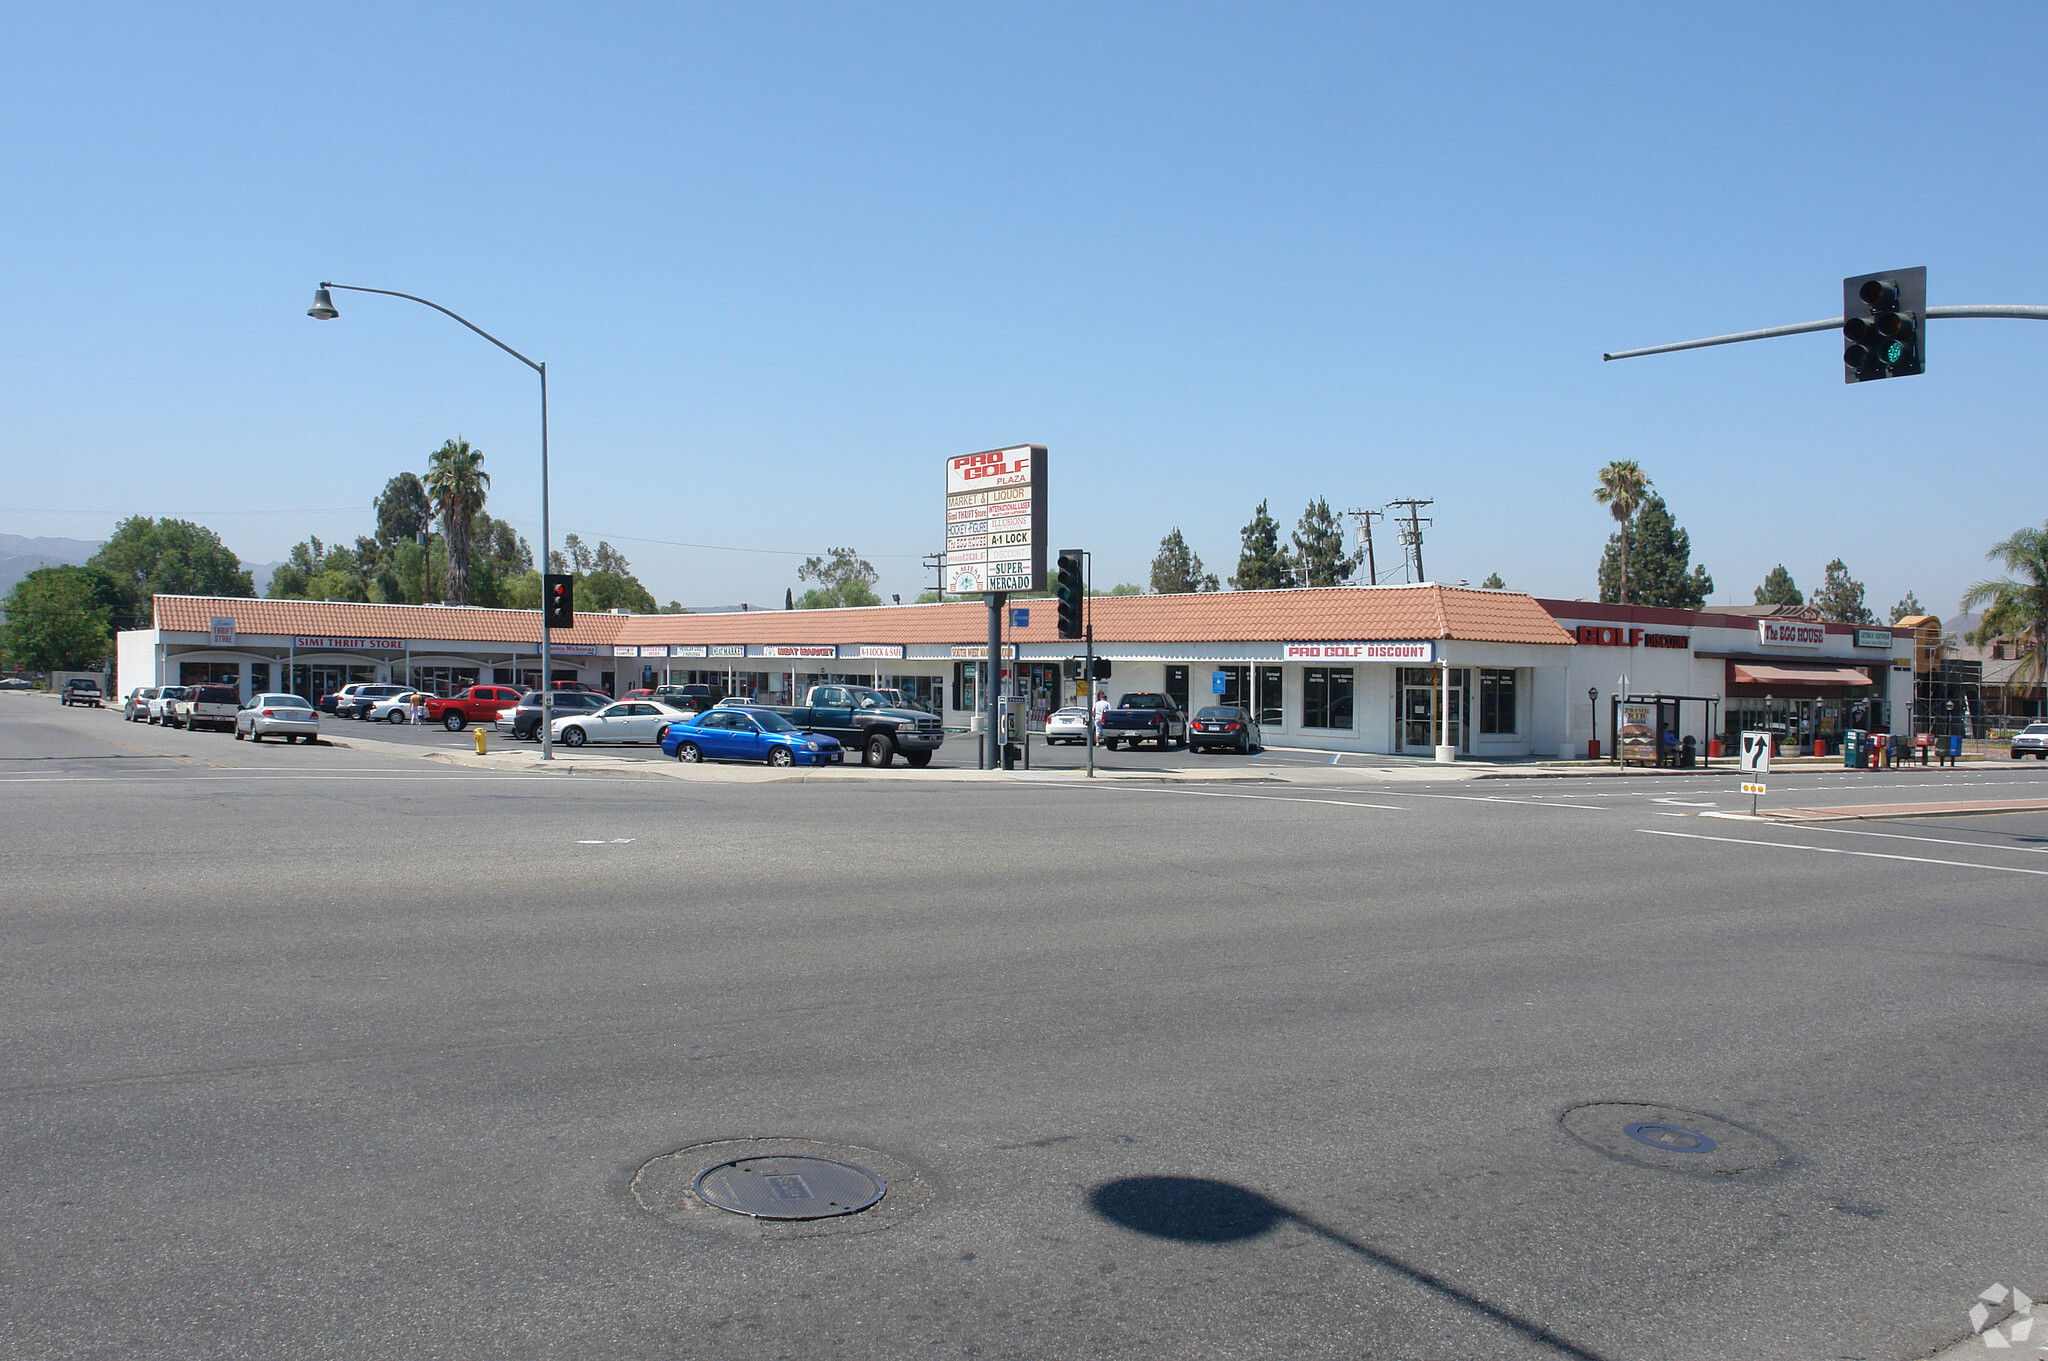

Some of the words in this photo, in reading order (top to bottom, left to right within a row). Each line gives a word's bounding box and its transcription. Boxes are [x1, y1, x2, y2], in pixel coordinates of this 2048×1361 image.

[954, 452, 1003, 470] PRO
[964, 458, 1029, 480] GOLF
[997, 475, 1026, 485] PLAZA
[949, 495, 977, 508] MARKET
[981, 493, 986, 503] &
[993, 488, 1024, 502] LIQUOR
[1018, 501, 1030, 510] LASER
[958, 510, 974, 520] THRIFT
[992, 517, 1026, 528] ILLUSIONS
[1006, 532, 1027, 544] LOCK
[994, 548, 1024, 559] DISCOUNT
[996, 562, 1023, 575] SUPER
[990, 576, 1030, 591] MERCADO
[213, 626, 233, 635] THRIFT
[1765, 625, 1779, 641] The
[1779, 626, 1796, 642] EGG
[1797, 627, 1824, 643] HOUSE
[214, 634, 233, 643] STORE
[1576, 625, 1645, 647] GOLF
[1644, 633, 1690, 649] DISCOUNT
[298, 638, 323, 647] SIMI
[328, 638, 365, 648] THRIFT
[369, 640, 404, 649] STORE
[800, 647, 834, 657] MARKET
[870, 647, 883, 656] LOCK
[889, 647, 901, 657] SAFE
[952, 648, 966, 657] SOUTH
[967, 648, 979, 657] WEST
[1288, 647, 1320, 657] PRO
[1324, 647, 1363, 657] GOLF
[1367, 647, 1425, 657] DISCOUNT
